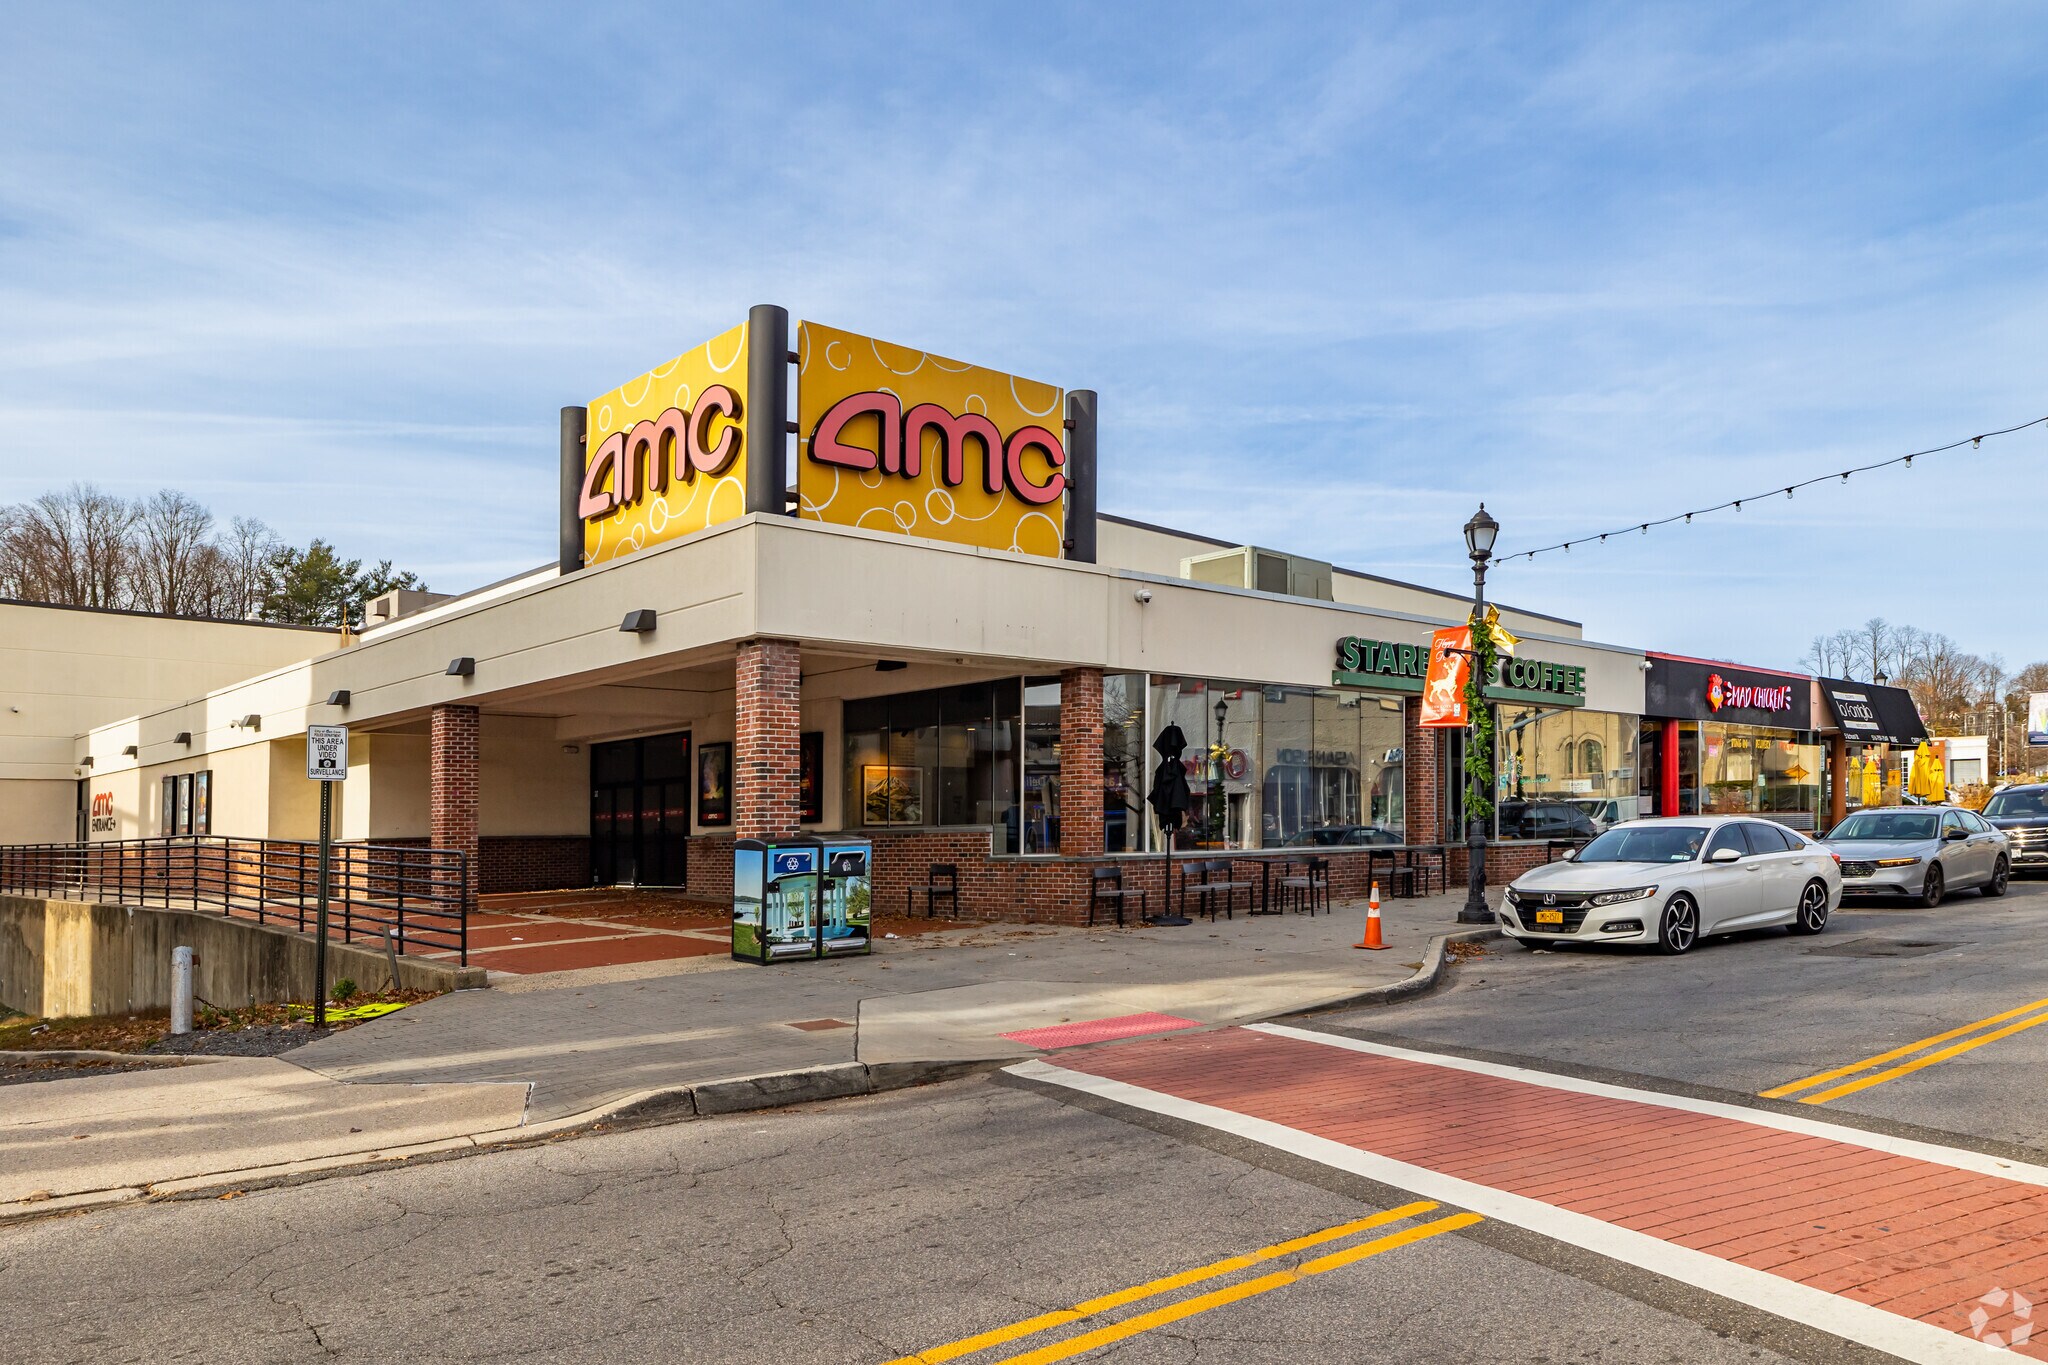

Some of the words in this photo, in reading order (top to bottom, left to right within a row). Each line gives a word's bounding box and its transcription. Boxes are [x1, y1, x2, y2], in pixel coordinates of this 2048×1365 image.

[578, 384, 743, 520] amc
[807, 391, 1066, 505] amc
[1338, 635, 1499, 684] STARBS
[1504, 656, 1587, 693] COFFEE
[1731, 685, 1752, 708] MAD
[1753, 686, 1786, 712] CHICKEN
[310, 768, 345, 776] SURVEILLANCE
[92, 791, 114, 817] amc
